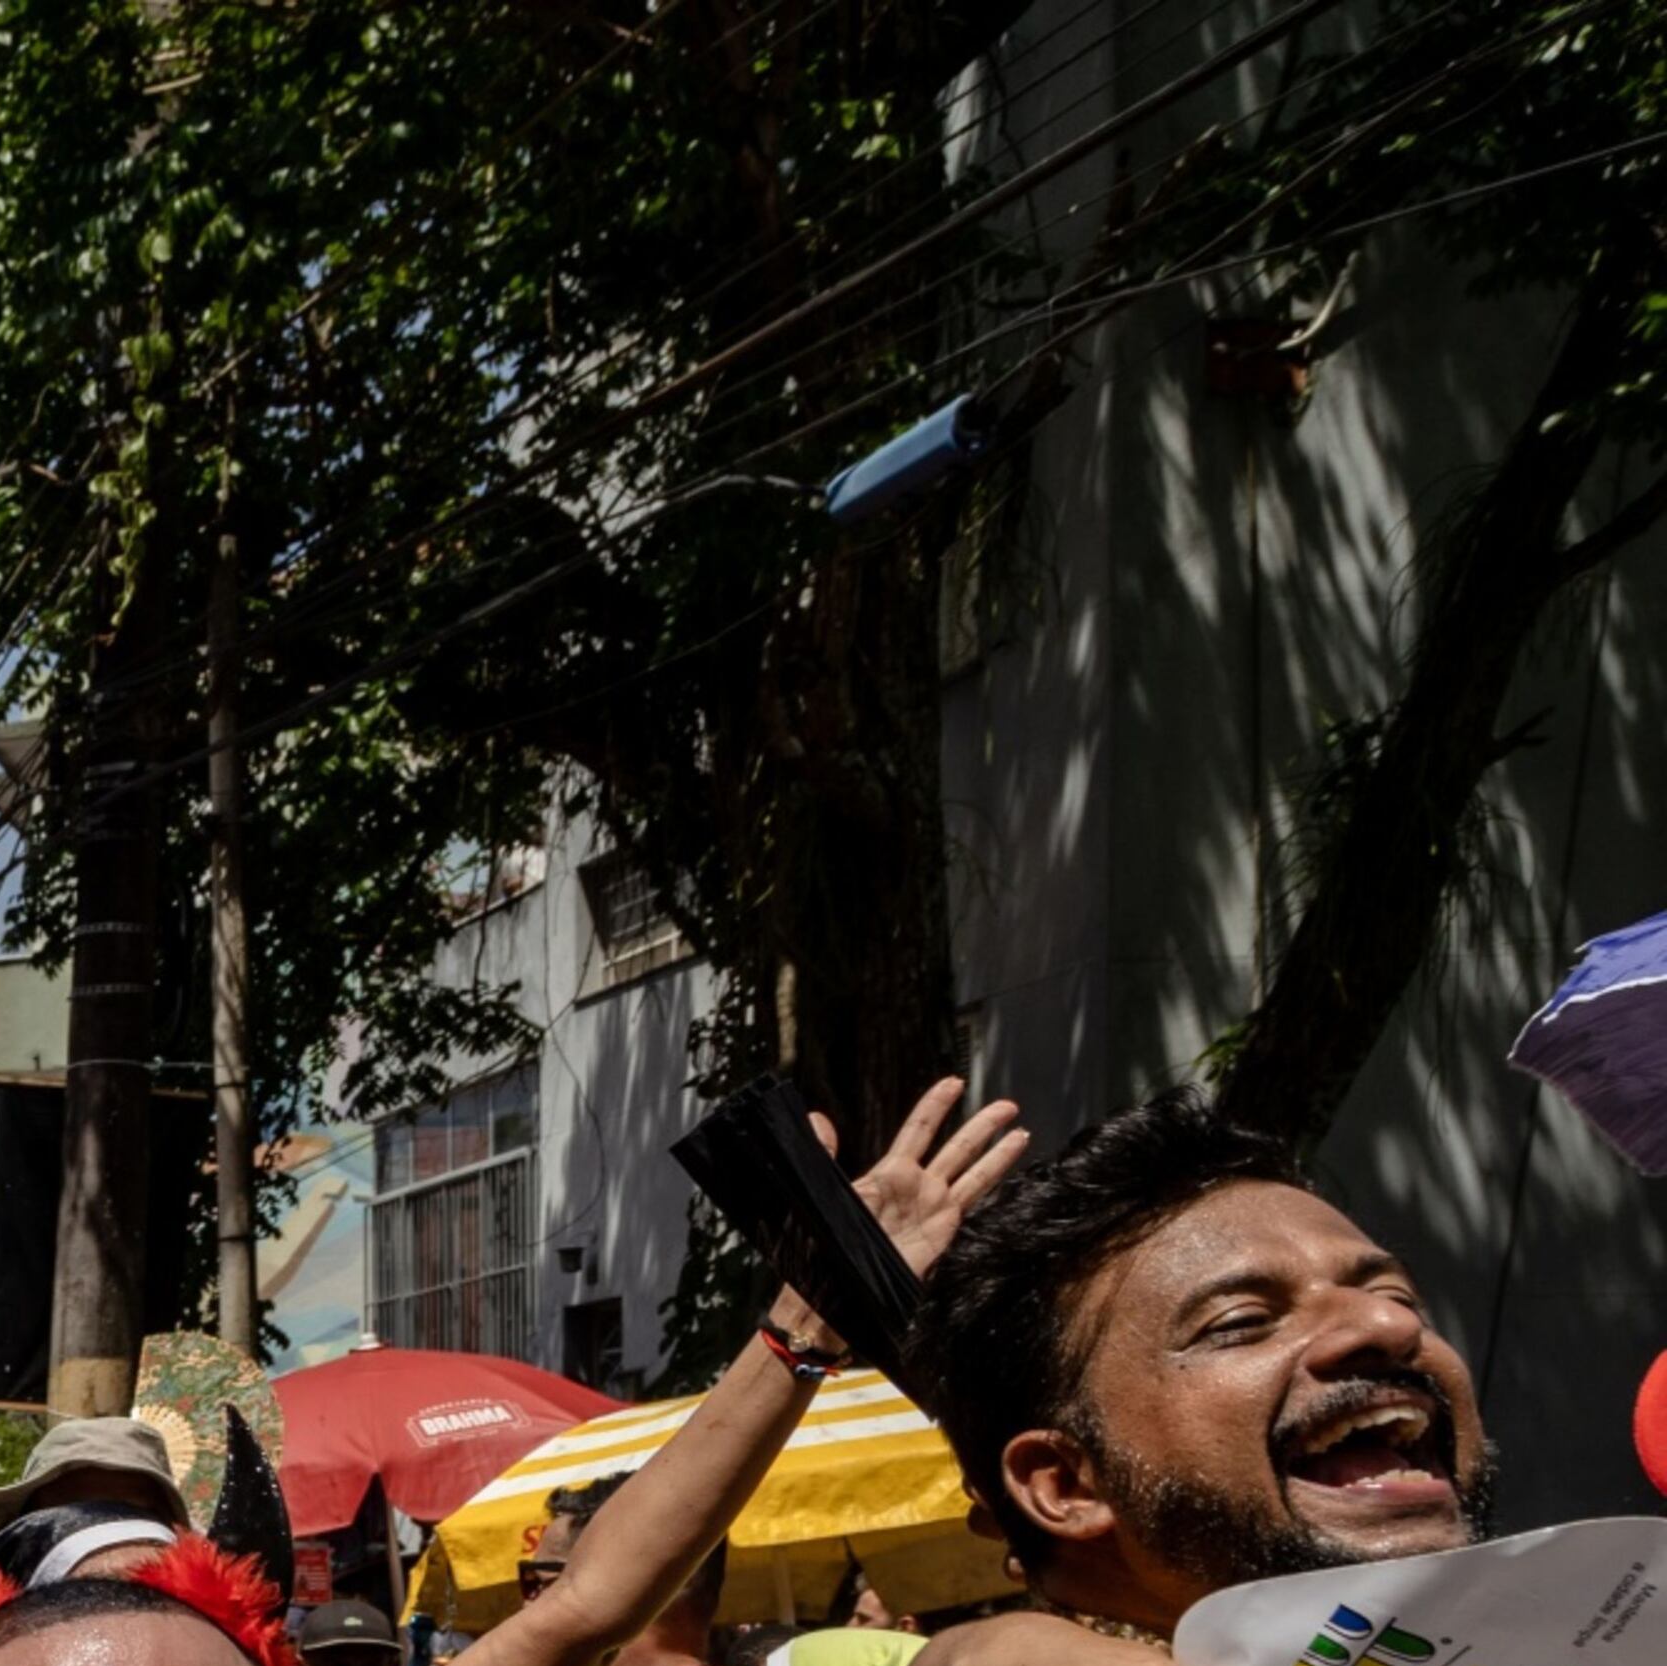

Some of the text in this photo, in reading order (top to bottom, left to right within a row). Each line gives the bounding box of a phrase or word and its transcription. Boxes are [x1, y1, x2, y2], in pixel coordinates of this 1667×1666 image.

[419, 1405, 512, 1435] BRAHMA
[1599, 1573, 1637, 1616] cidade
[1601, 1583, 1658, 1643] Mantenha
[1572, 1615, 1608, 1648] limpa
